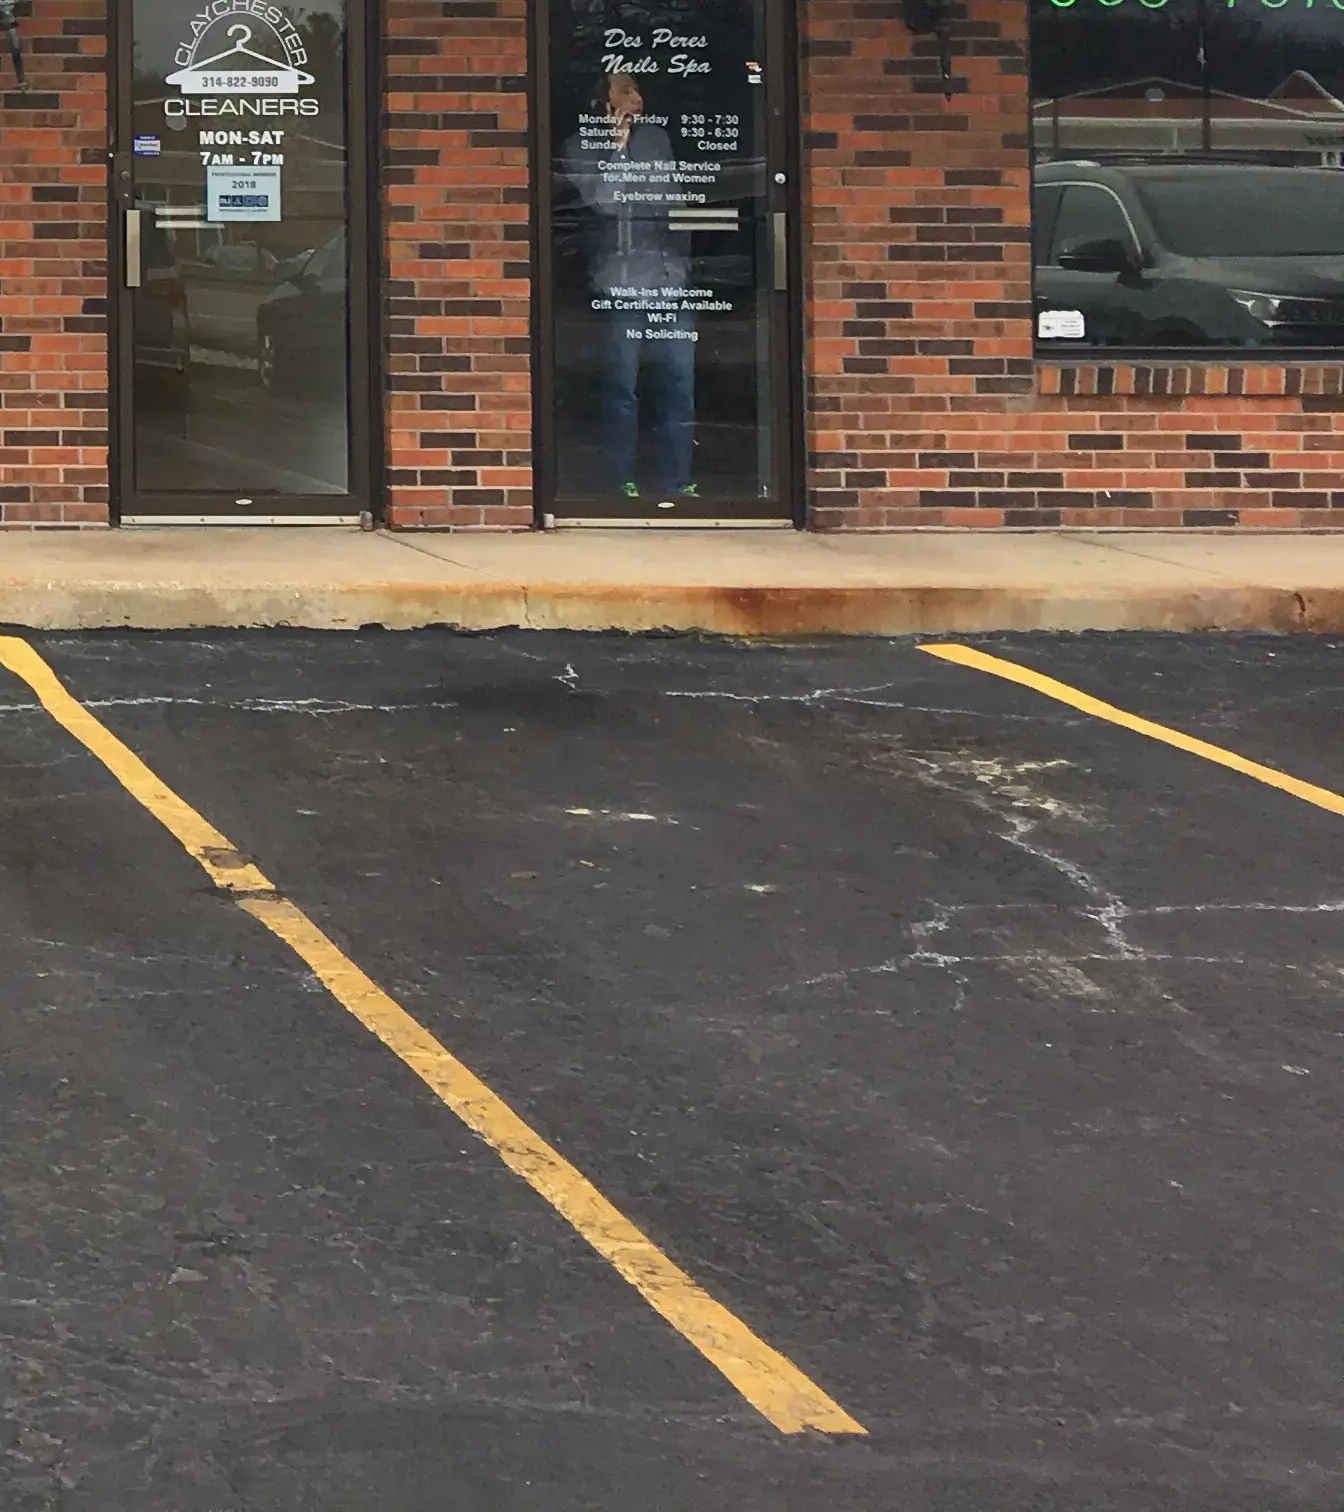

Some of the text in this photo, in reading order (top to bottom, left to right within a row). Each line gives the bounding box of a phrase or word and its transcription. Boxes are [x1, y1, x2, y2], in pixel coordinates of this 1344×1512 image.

[603, 27, 709, 48] Des Peres
[600, 54, 713, 77] Nails Spa
[202, 76, 279, 88] 314-822-9090
[164, 98, 320, 116] CLEANERS
[578, 114, 623, 126] Monday
[633, 114, 669, 126] Friday
[680, 114, 705, 125] 9:30
[714, 114, 739, 125] 7:30
[199, 130, 285, 145] MON-SAT
[579, 127, 630, 138] Saturday
[680, 127, 705, 138] 9:30
[714, 127, 739, 138] 6:30
[580, 140, 737, 151] Sunday Closed
[199, 151, 234, 166] 7AM
[251, 151, 284, 165] 7PM
[597, 160, 721, 172] Complete Nail Service
[603, 173, 716, 183] for Men and Women
[231, 180, 257, 189] 2018
[613, 191, 706, 203] Eyebrow waxing
[610, 287, 713, 298] Walk-Ins Welcome
[591, 299, 733, 311] Gift Certificates Available
[647, 312, 677, 323] Wi-Fi
[626, 328, 699, 342] No Soliciting
